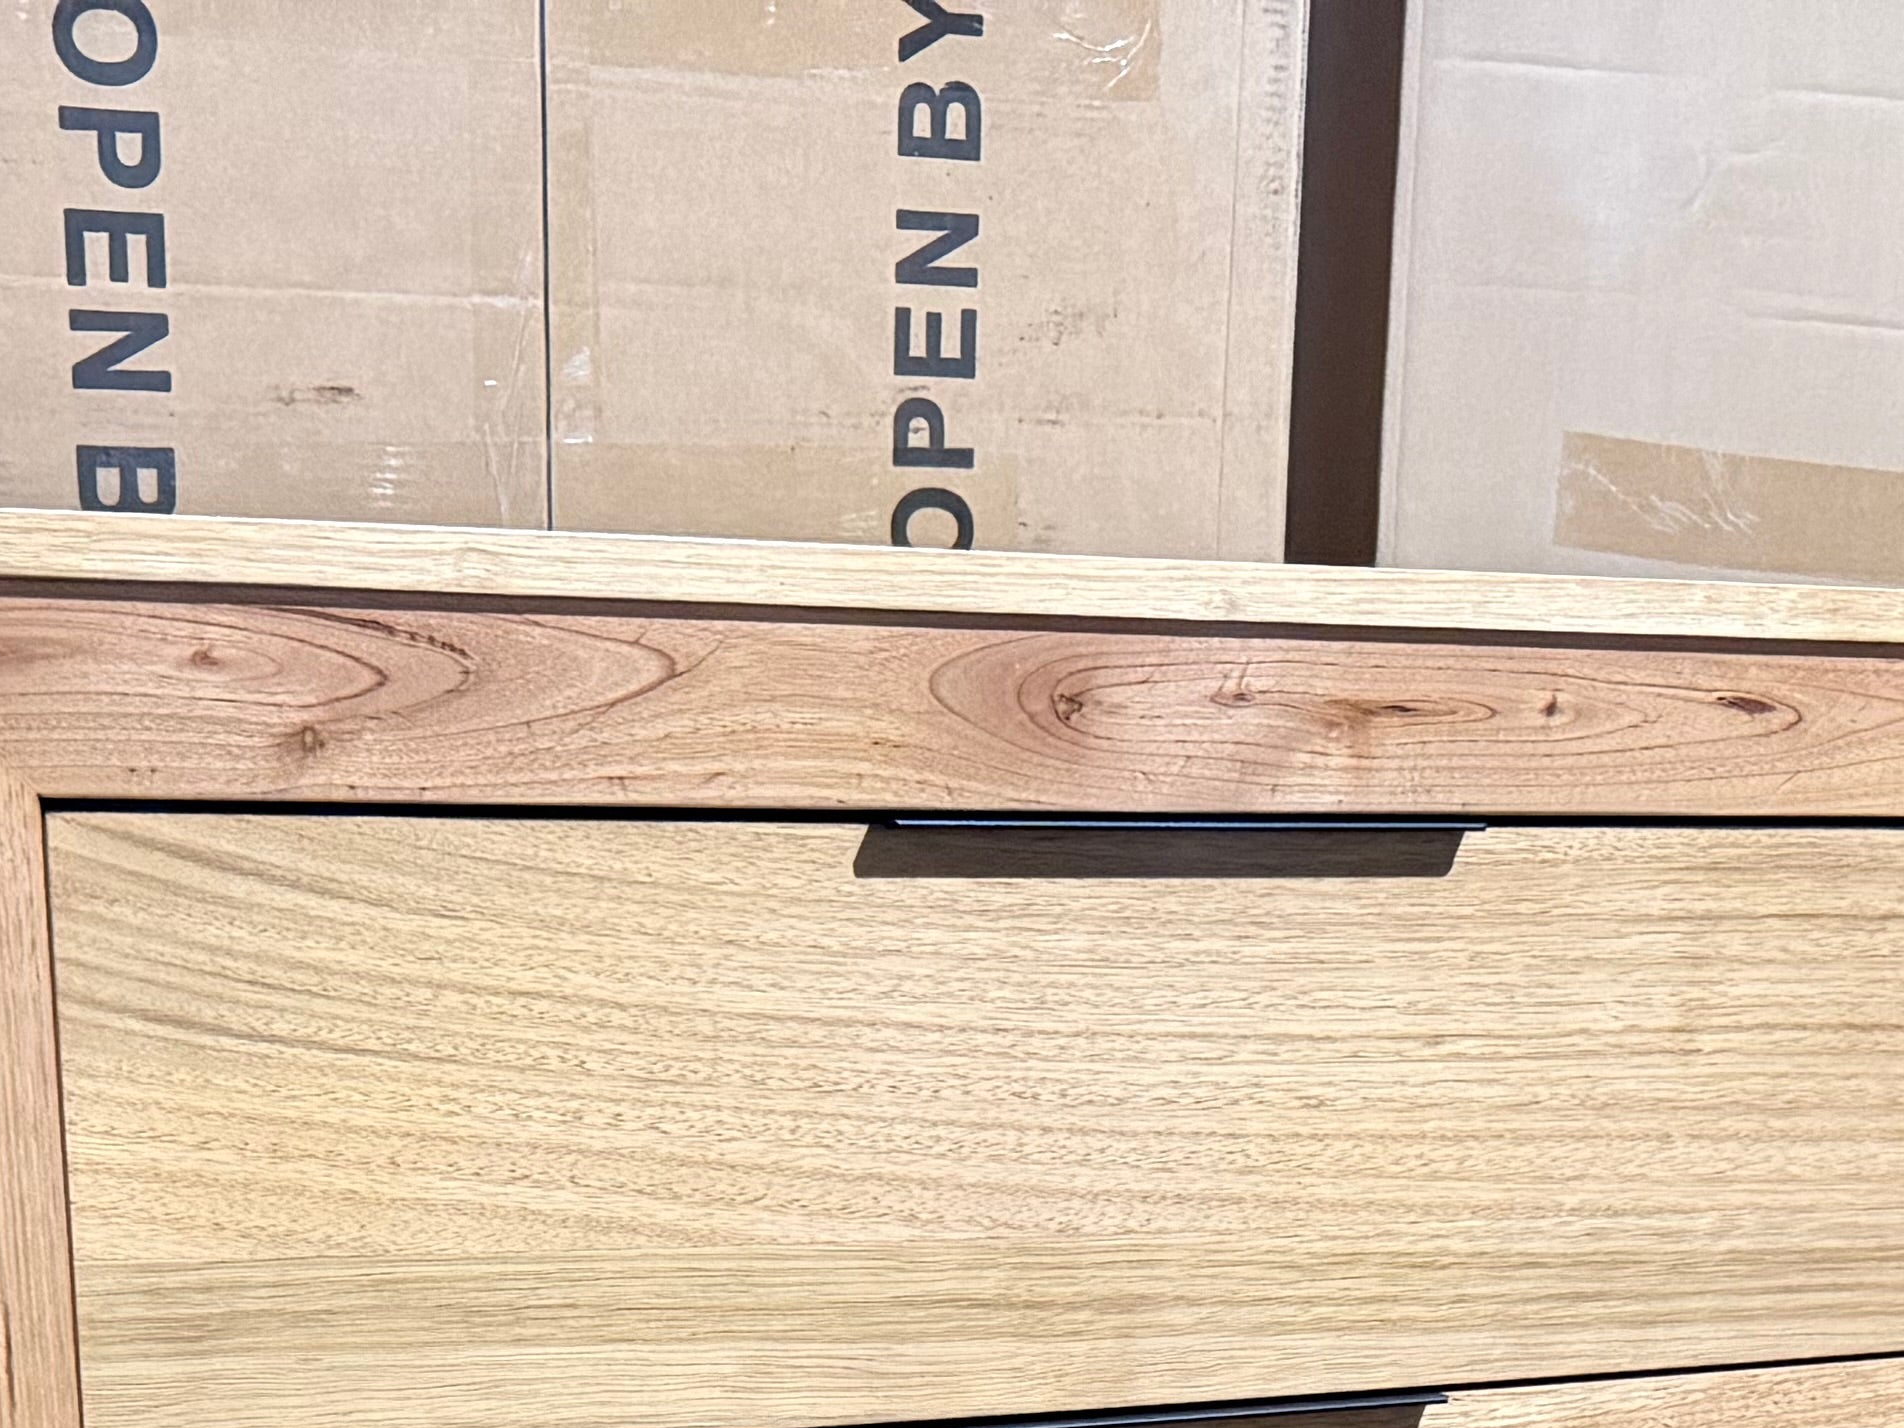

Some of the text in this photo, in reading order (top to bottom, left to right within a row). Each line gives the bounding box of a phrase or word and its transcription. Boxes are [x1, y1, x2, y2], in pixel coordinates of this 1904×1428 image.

[52, 0, 177, 515] OPEN B
[890, 0, 984, 551] OPEN BY
